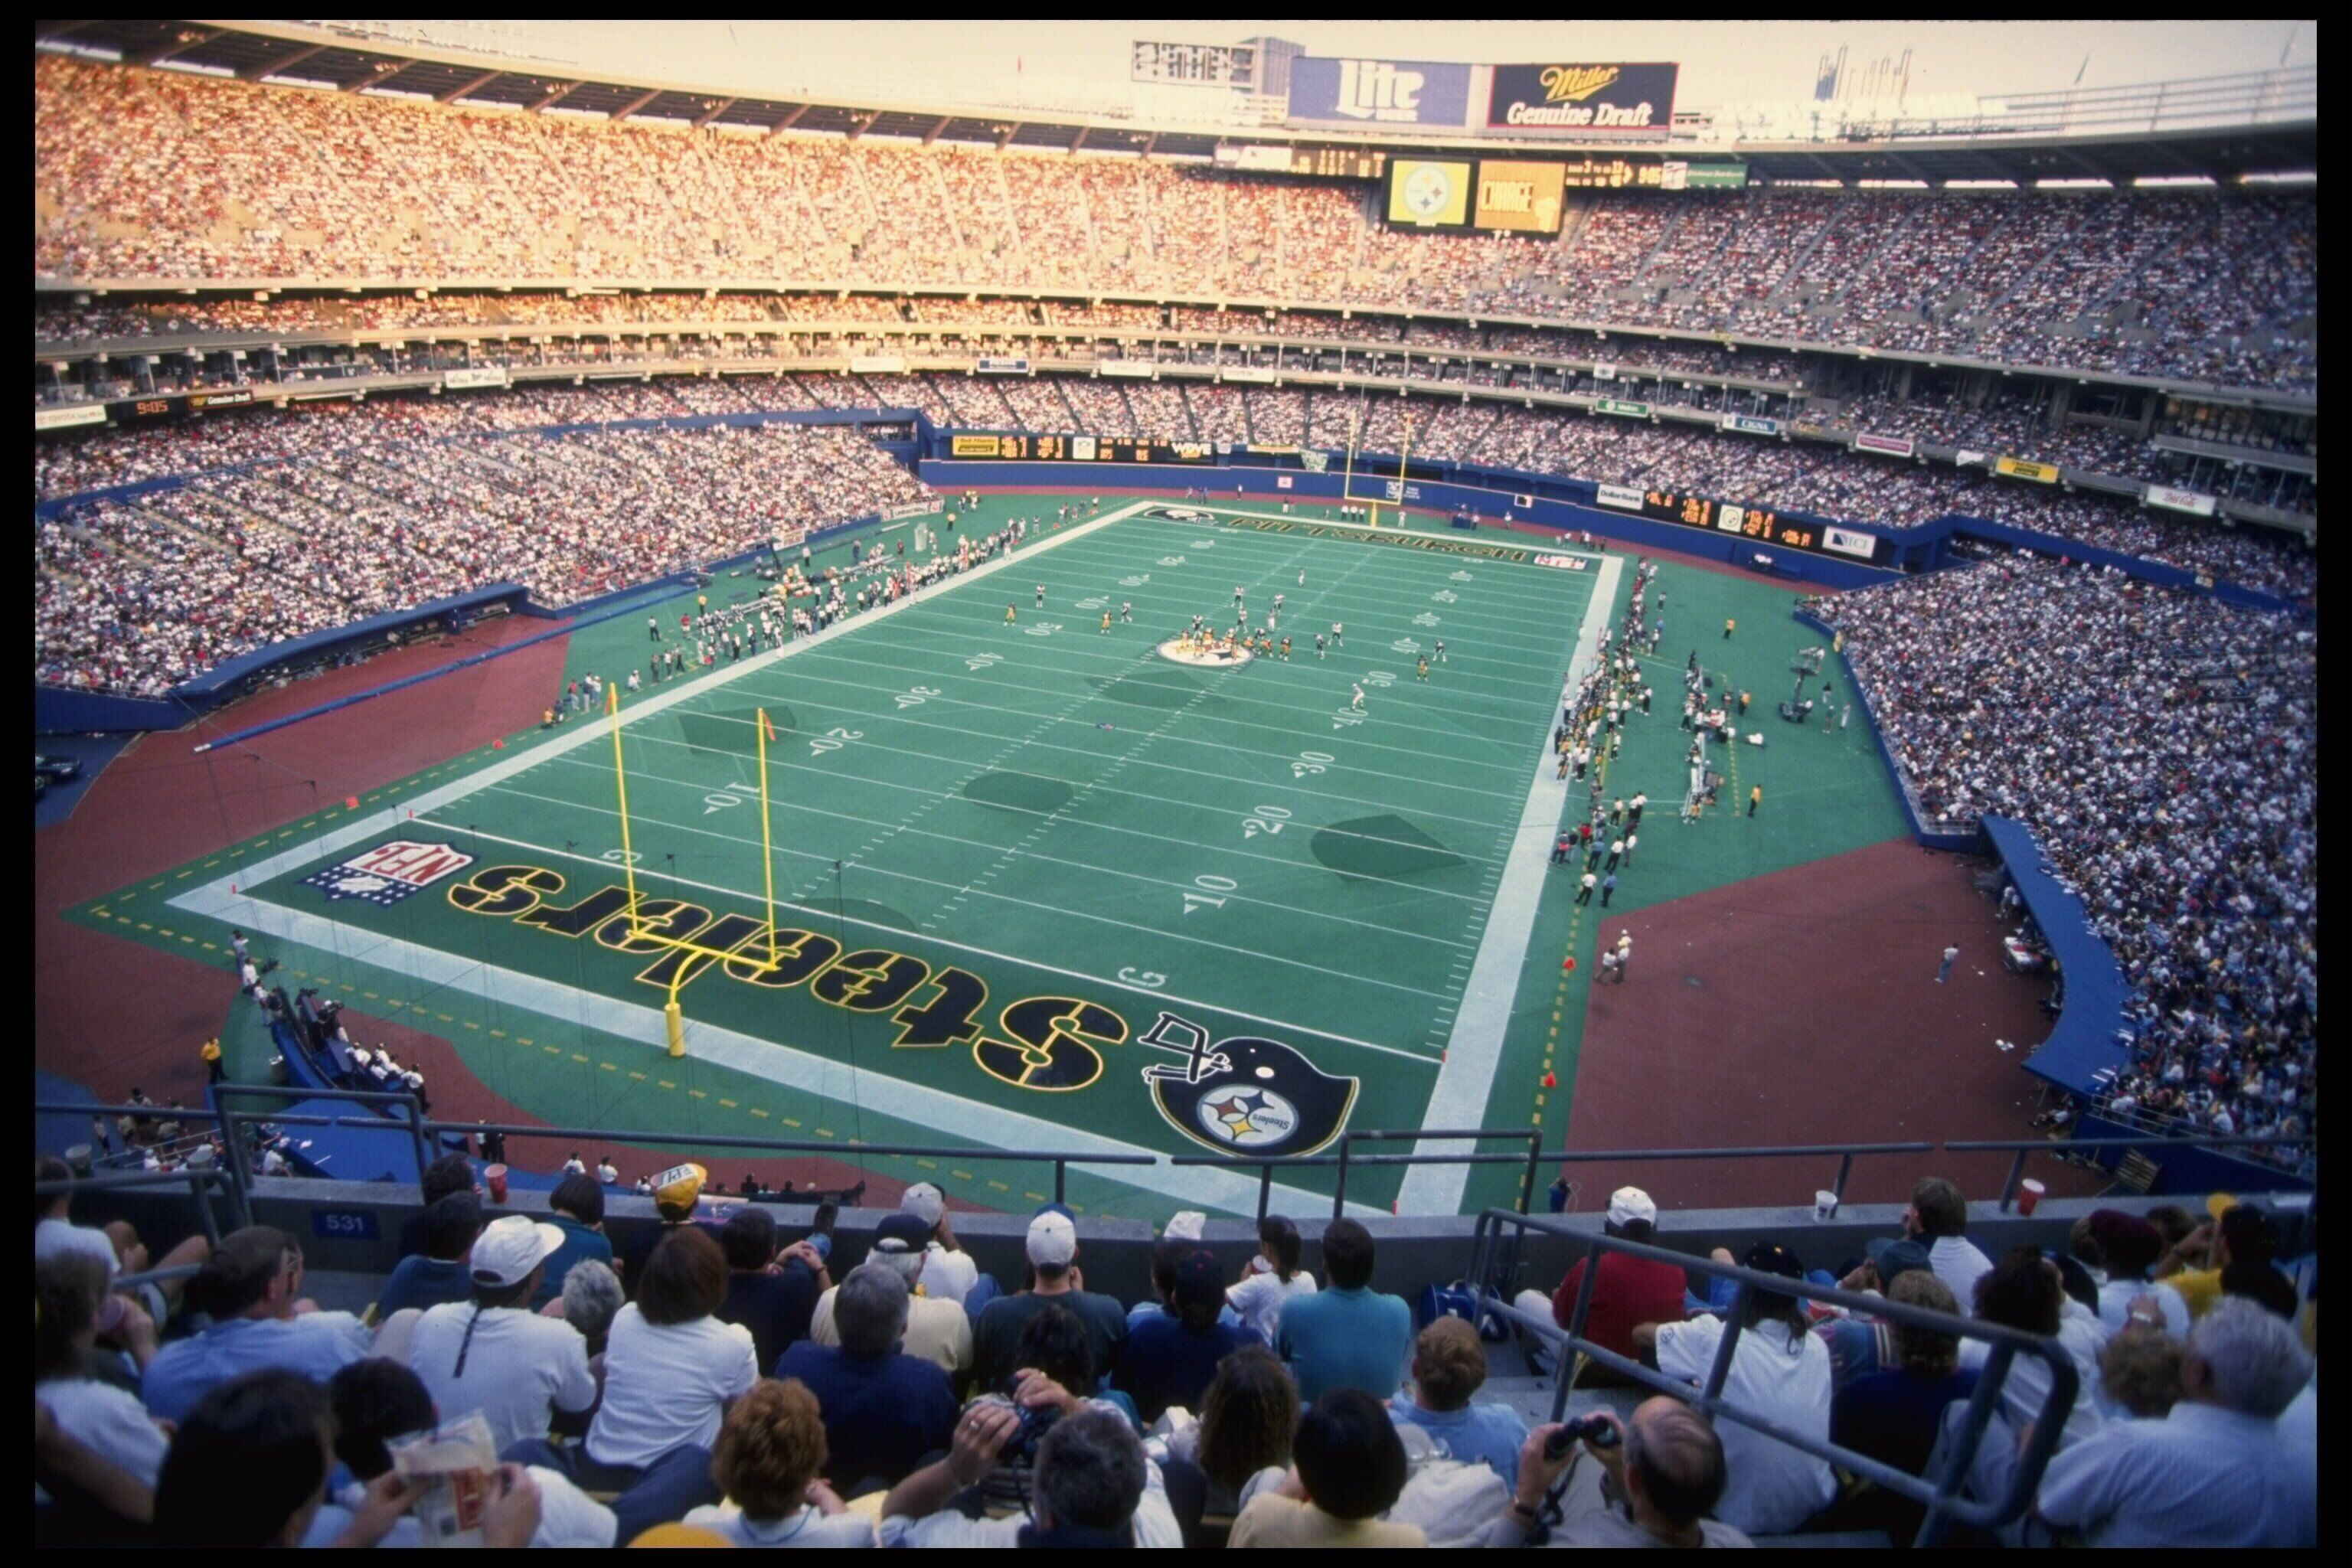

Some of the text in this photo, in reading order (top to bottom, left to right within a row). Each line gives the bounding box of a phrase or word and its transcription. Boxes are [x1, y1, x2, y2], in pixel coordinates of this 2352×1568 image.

[1336, 60, 1425, 119] Lite
[1540, 67, 1619, 103] Miller
[1508, 102, 1652, 127] Genuine Draft
[1481, 181, 1534, 213] CHARGE
[136, 400, 168, 415] 9:05
[207, 395, 234, 405] Genuine
[1741, 419, 1769, 430] CIGNA
[1171, 443, 1213, 456] WDVE
[1600, 489, 1621, 499] Dollar
[1621, 492, 1641, 502] Bank
[1227, 517, 1527, 562] PITTSBURGH
[894, 685, 942, 707] 30
[1331, 707, 1369, 727] 40
[809, 727, 864, 752] 20
[1290, 751, 1335, 774] 30
[704, 781, 761, 810] 10
[1242, 805, 1292, 835] 20
[357, 843, 466, 885] NFL
[1181, 874, 1238, 909] 10
[447, 864, 1129, 1093] Steelers
[1251, 1112, 1291, 1131] Steelers
[326, 1214, 364, 1232] 531
